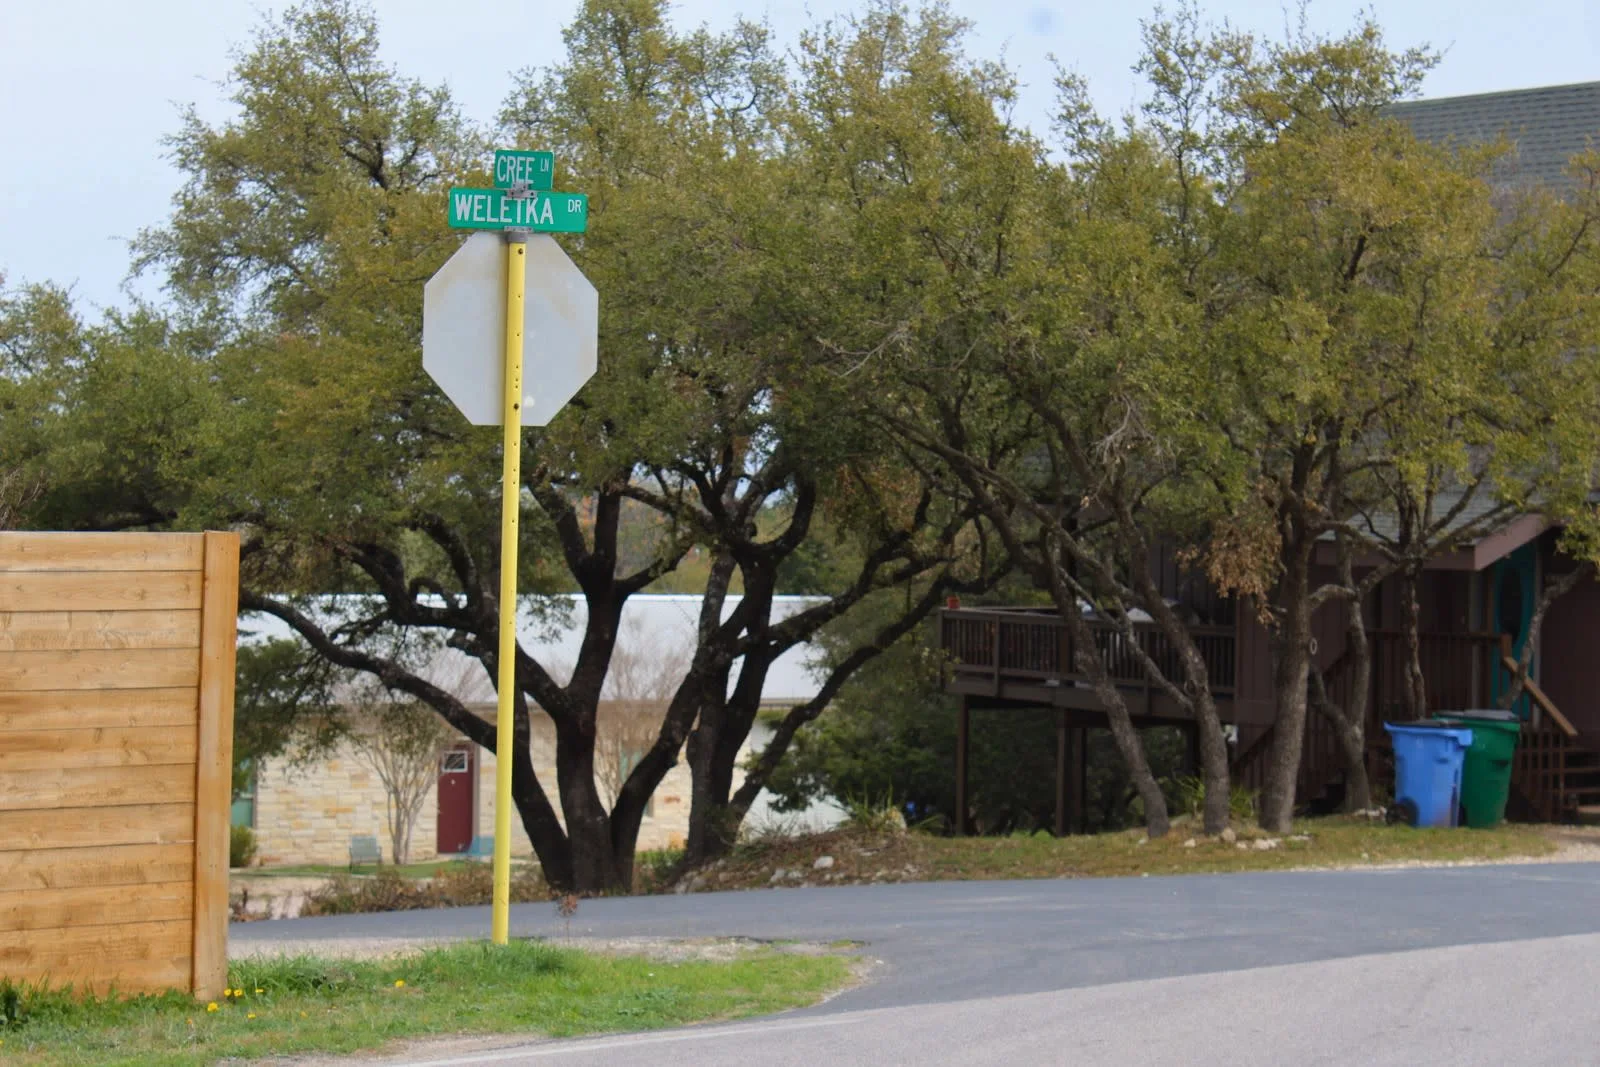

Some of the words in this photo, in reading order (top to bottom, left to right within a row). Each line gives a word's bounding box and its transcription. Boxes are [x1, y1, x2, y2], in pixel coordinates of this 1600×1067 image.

[497, 155, 535, 184] CREE
[540, 158, 550, 172] LN
[454, 193, 554, 225] WELETKA
[567, 199, 582, 213] DR
